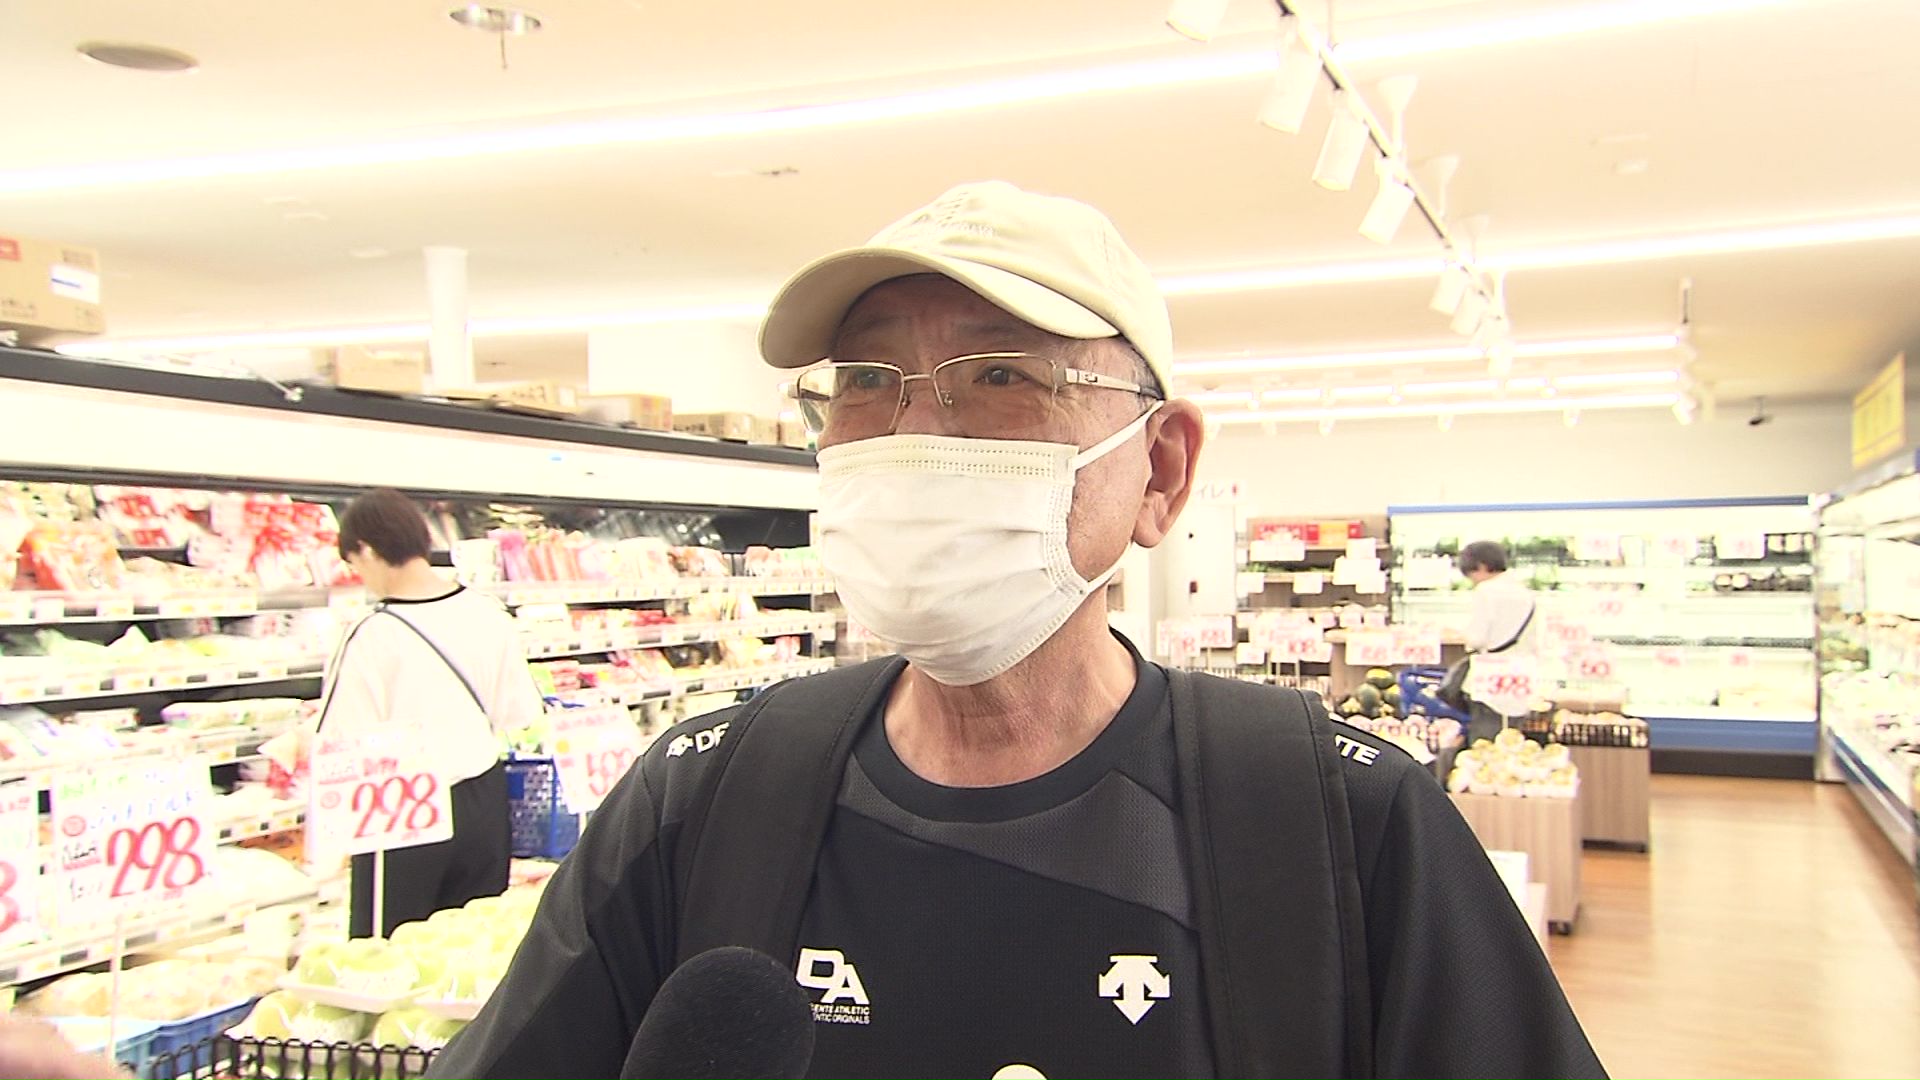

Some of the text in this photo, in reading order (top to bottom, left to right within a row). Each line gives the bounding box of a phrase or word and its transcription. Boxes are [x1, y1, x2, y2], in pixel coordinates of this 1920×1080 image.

[350, 771, 440, 840] 298
[105, 814, 206, 899] 298
[834, 1004, 870, 1016] ATHLETIC
